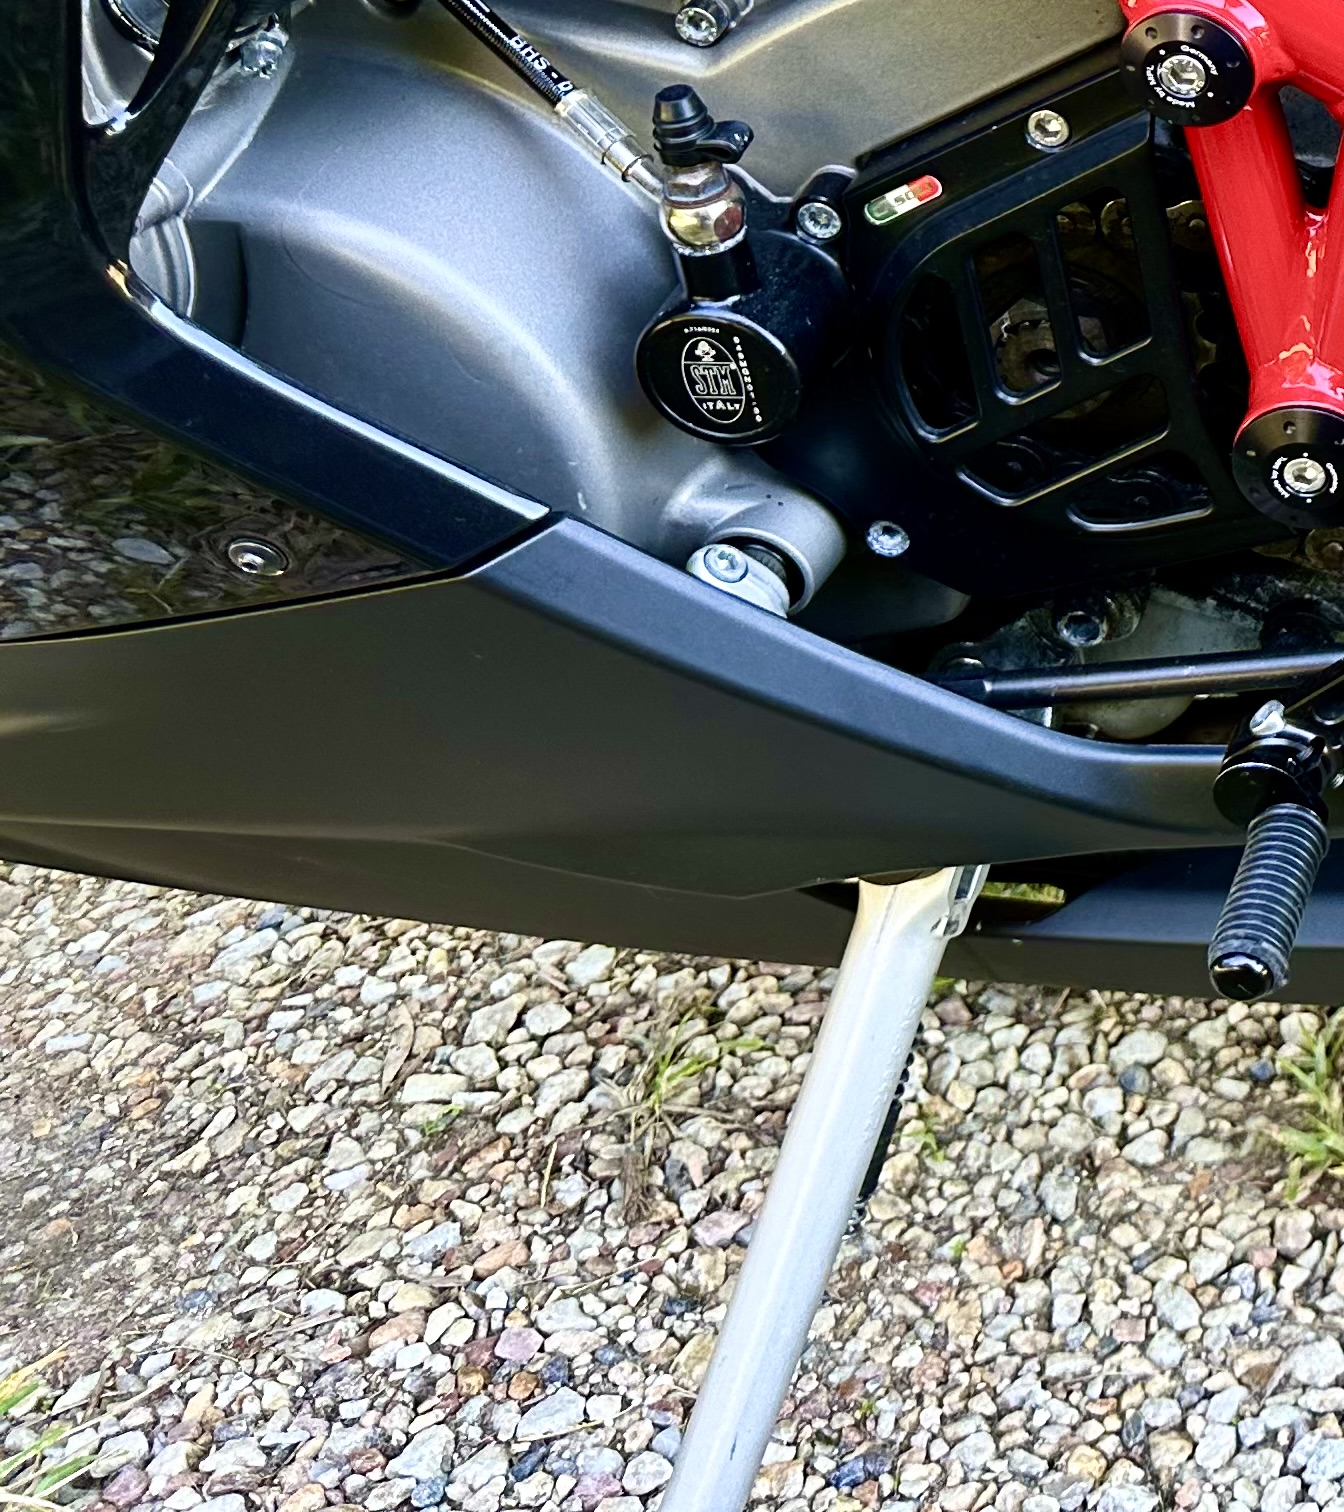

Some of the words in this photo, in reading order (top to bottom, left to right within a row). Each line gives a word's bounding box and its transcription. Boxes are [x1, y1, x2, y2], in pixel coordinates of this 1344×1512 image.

[1181, 45, 1218, 75] Germany
[690, 365, 736, 395] STM
[702, 399, 740, 410] ITALY
